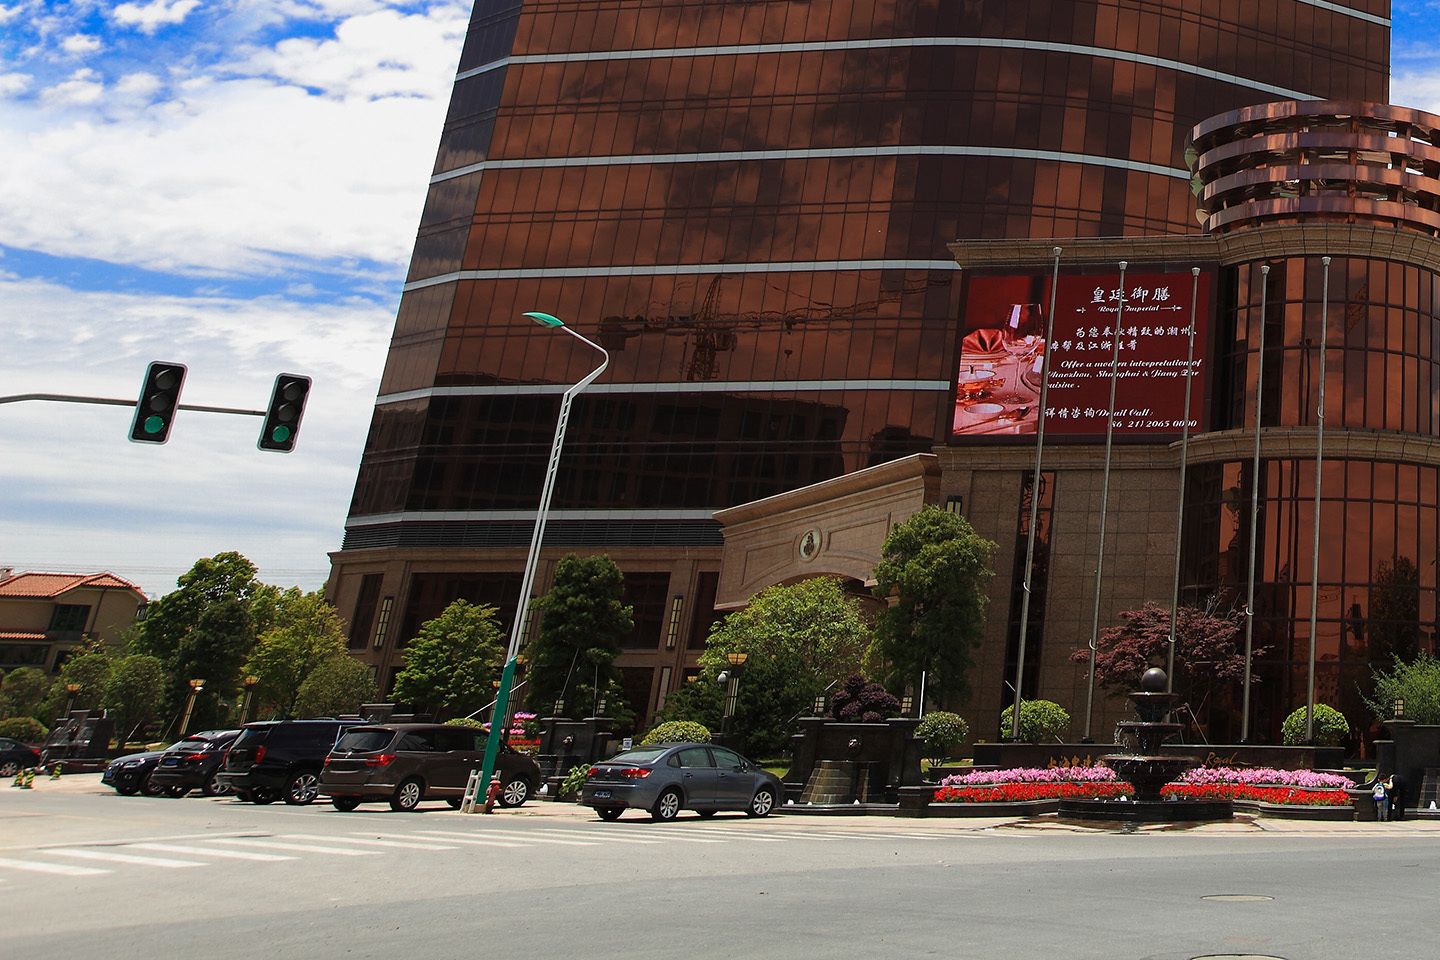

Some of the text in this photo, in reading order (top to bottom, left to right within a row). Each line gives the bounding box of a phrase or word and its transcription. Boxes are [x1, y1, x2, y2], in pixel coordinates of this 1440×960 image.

[1124, 304, 1160, 312] Imperial
[1060, 360, 1084, 368] Offer
[1094, 359, 1128, 367] modrn
[1191, 358, 1203, 367] of
